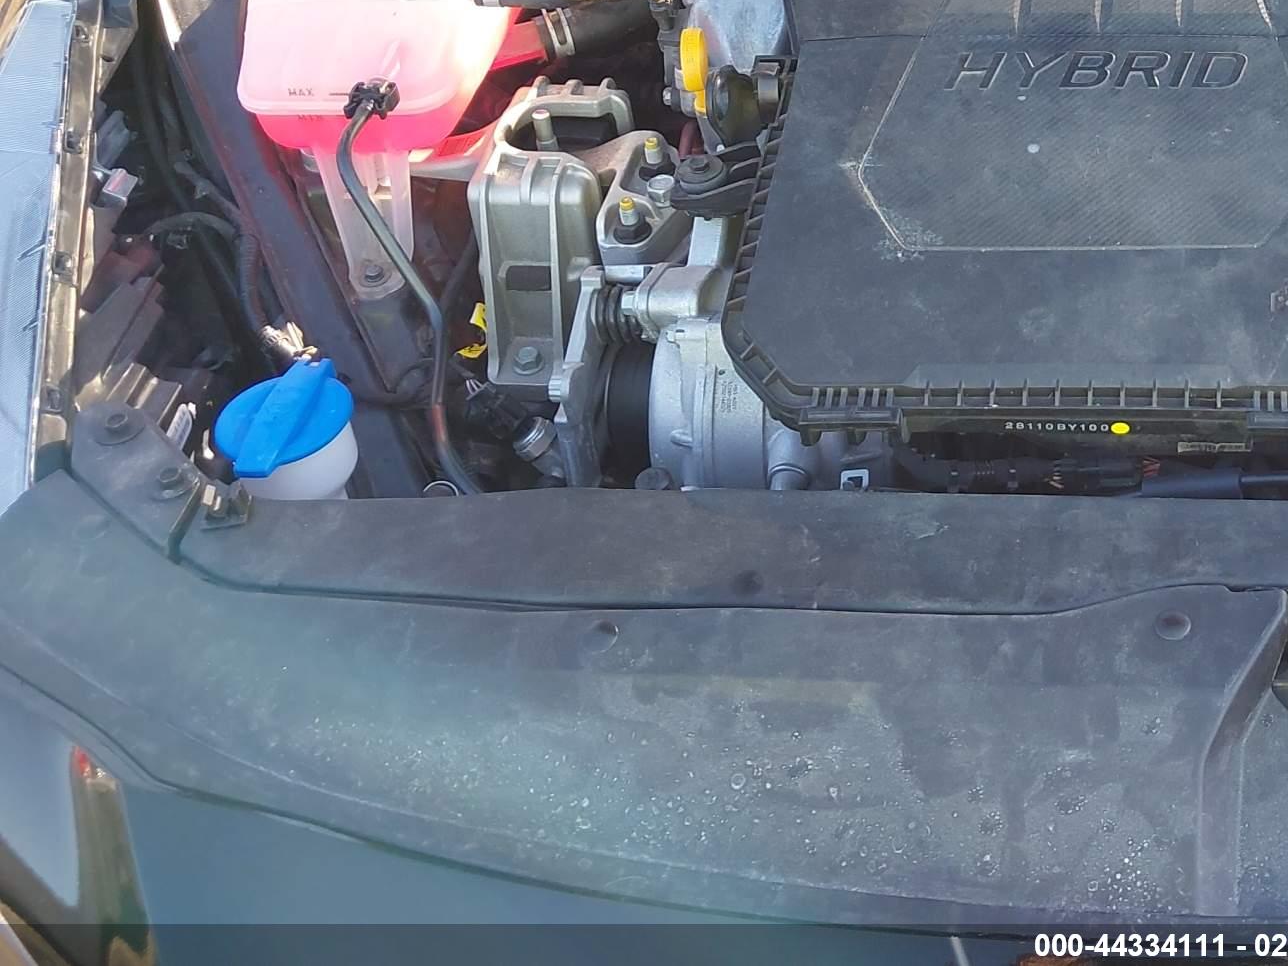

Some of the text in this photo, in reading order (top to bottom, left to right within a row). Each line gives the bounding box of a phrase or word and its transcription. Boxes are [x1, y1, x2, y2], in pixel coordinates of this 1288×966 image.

[943, 50, 1248, 90] HYBRID
[287, 87, 314, 96] MAX
[1004, 421, 1109, 432] 28110BY100
